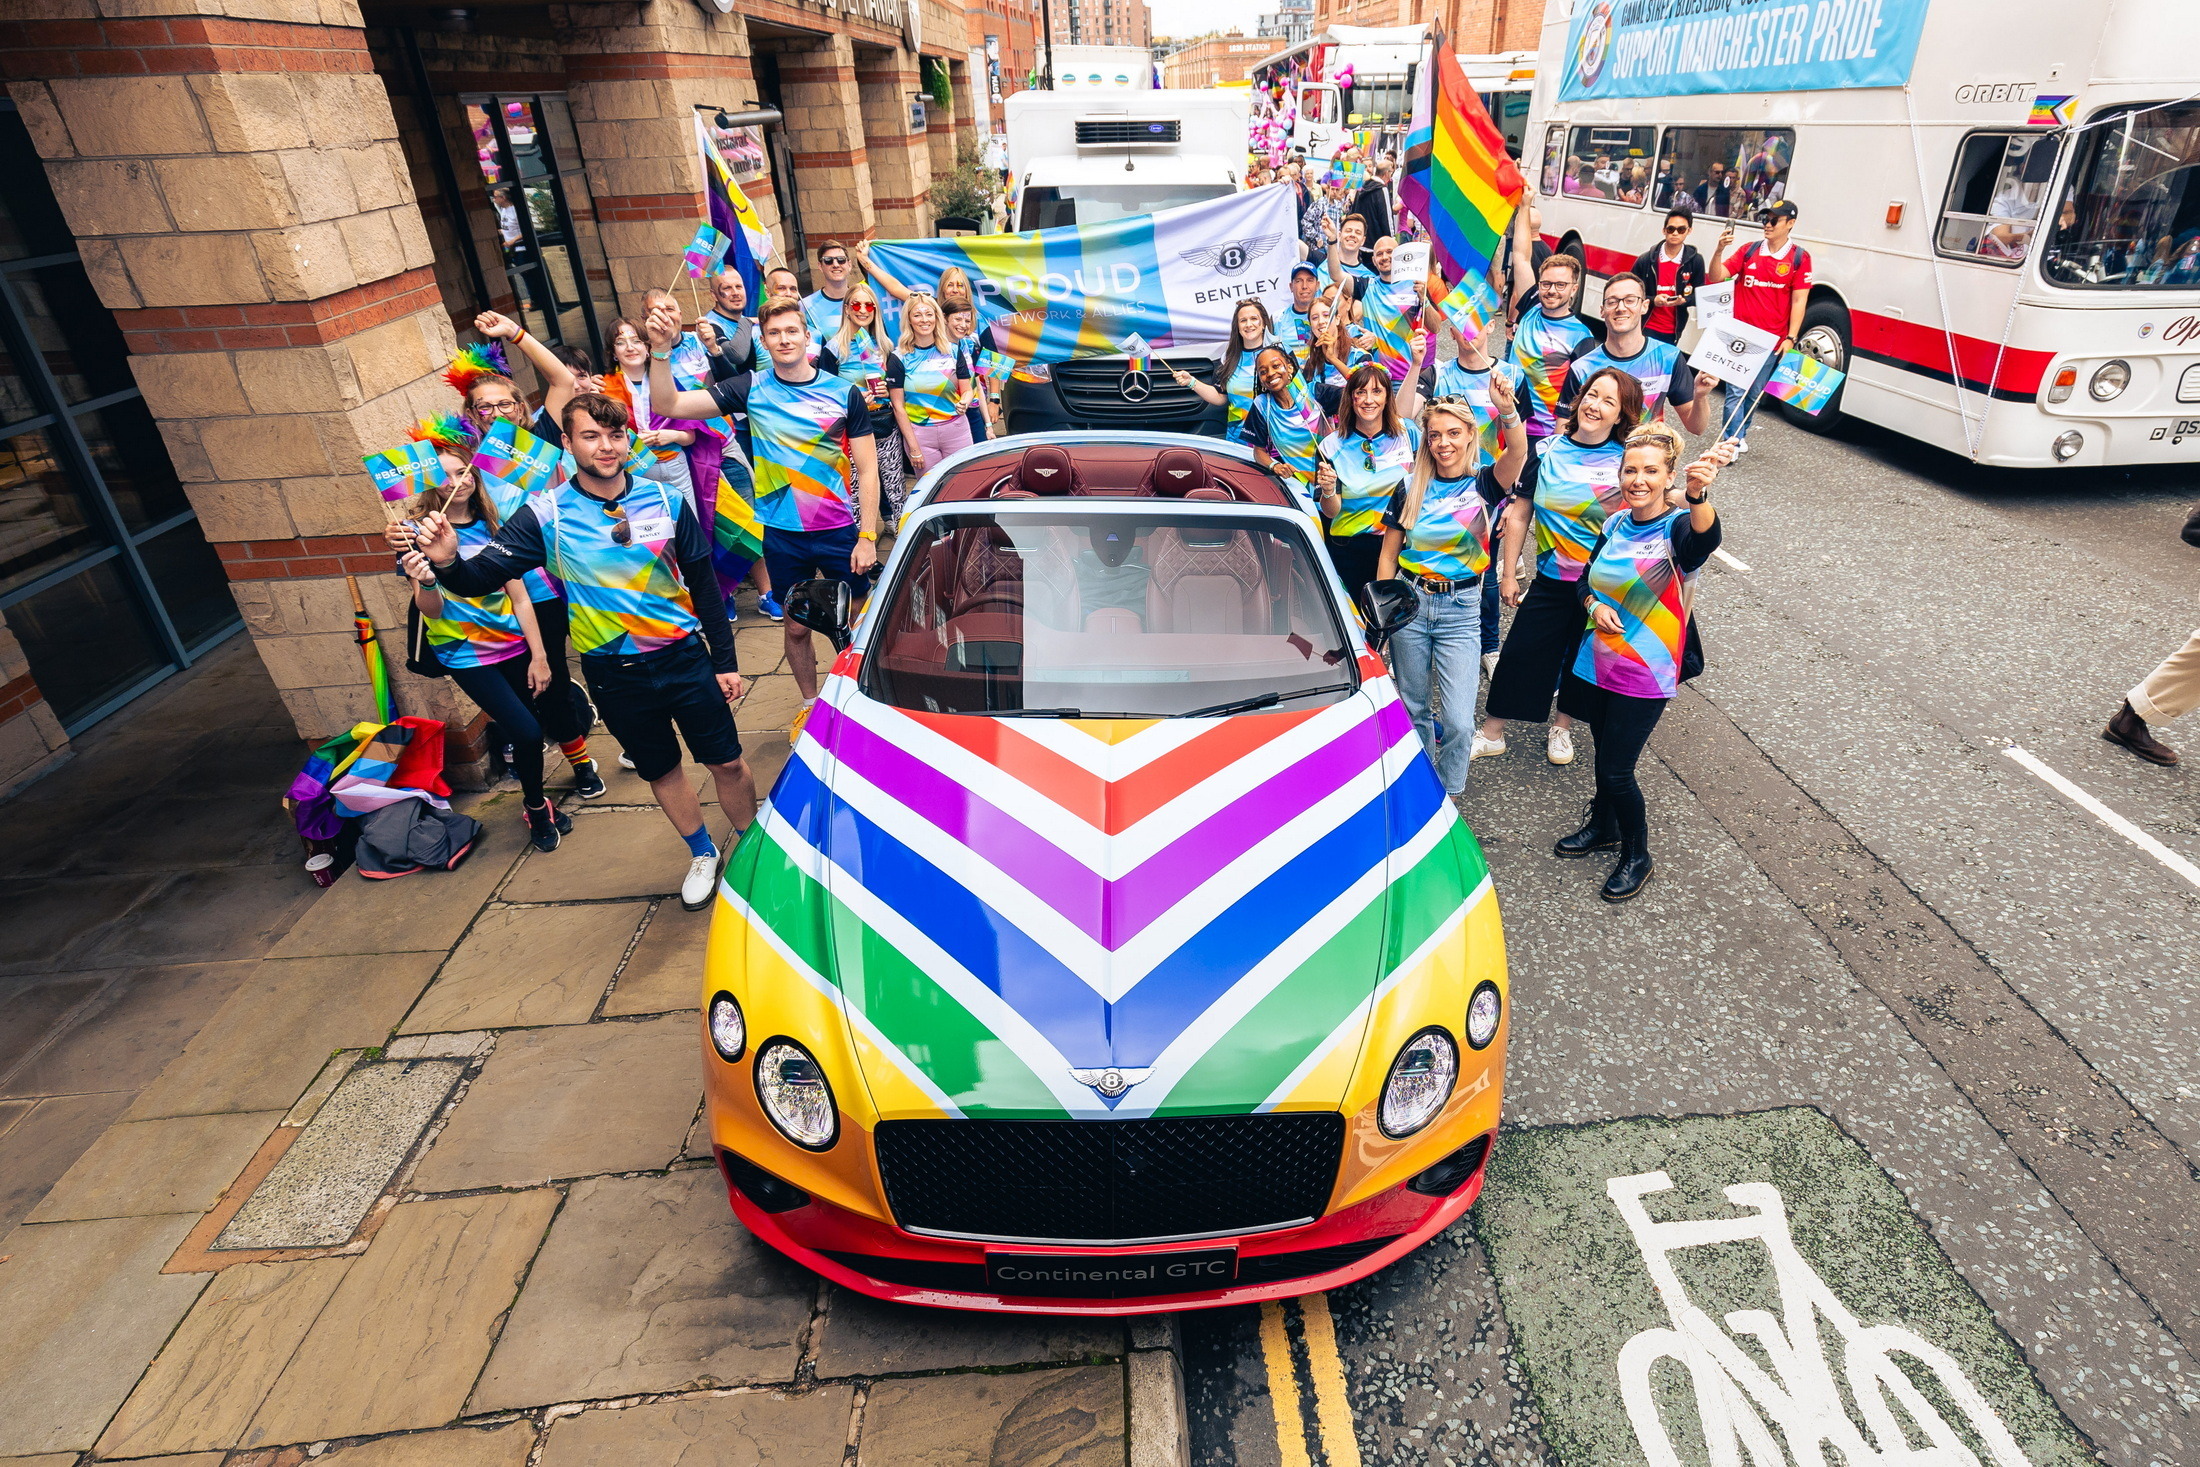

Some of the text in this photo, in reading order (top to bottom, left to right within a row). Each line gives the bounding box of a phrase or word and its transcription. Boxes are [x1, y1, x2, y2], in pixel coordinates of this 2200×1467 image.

[1245, 43, 1270, 52] STATION
[1612, 0, 1883, 79] SUPPORT MANCHESTER PRIDE
[1955, 83, 2036, 104] ORBIT
[1394, 267, 1423, 275] BENTLEY
[1195, 277, 1280, 304] BENTLEY
[987, 301, 1146, 327] NETWORK & ALLIES
[1704, 351, 1751, 375] BENTLEY
[1778, 365, 1831, 395] #BEPROUD
[2175, 421, 2200, 435] DS
[487, 436, 550, 473] #BEPROUD
[375, 457, 438, 480] #BEPROUD
[996, 1260, 1226, 1281] Continental GTC
